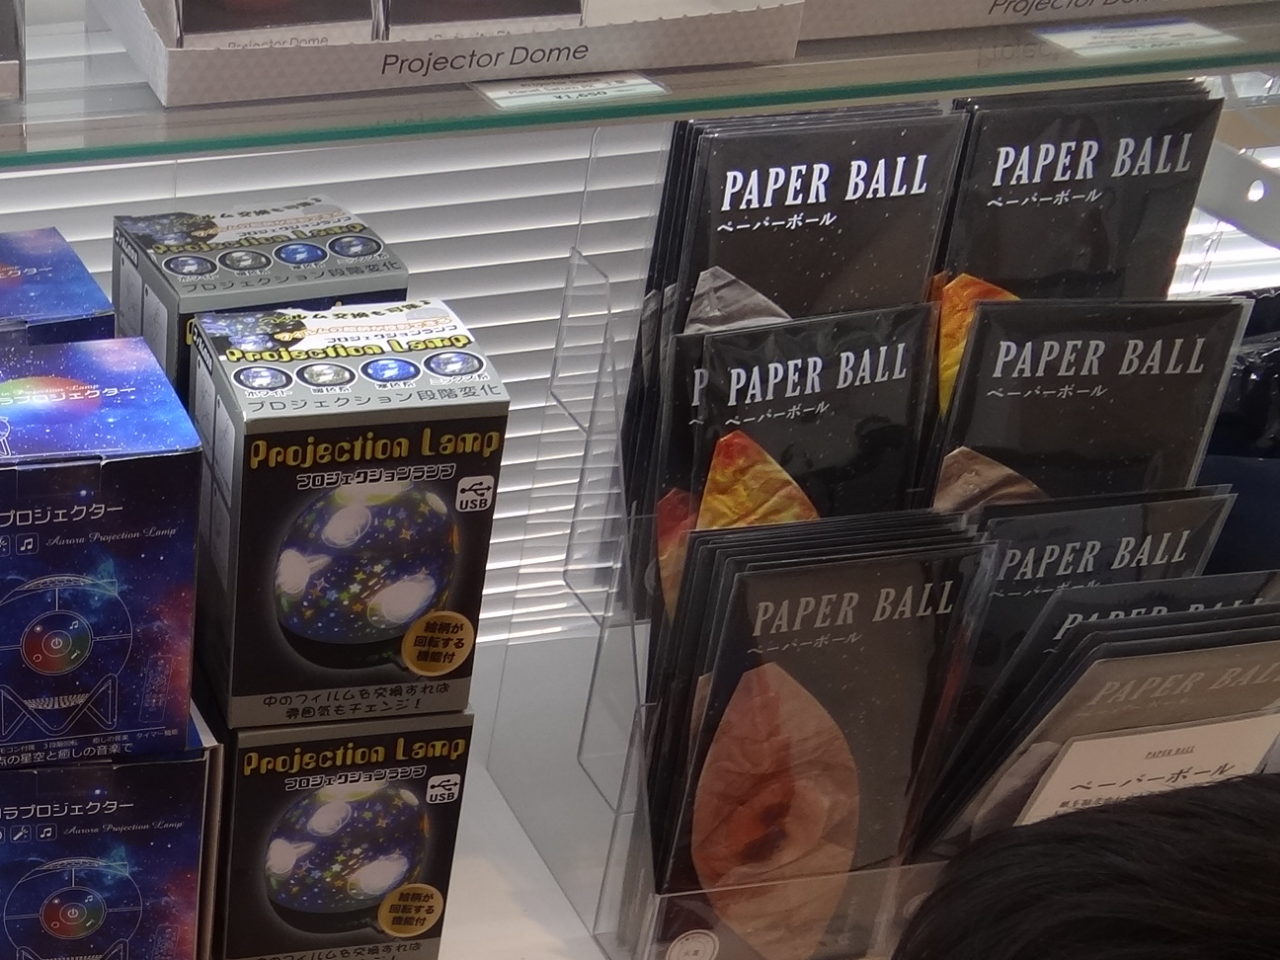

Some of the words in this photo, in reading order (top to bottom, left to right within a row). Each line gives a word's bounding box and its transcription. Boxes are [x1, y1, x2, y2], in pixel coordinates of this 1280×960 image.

[381, 48, 504, 76] Projector
[509, 42, 590, 68] Dome
[991, 139, 1098, 187] PAPER
[1111, 132, 1193, 178] BALL
[721, 163, 829, 211] PAPER
[845, 154, 928, 201] BALL
[987, 188, 1102, 208] ペーパーボール
[717, 212, 837, 232] ペーパーボール
[226, 343, 384, 364] Projection
[388, 334, 472, 354] Lamp
[991, 340, 1103, 379] PAPER
[1119, 337, 1207, 376] BALL
[727, 357, 823, 407] PAPER
[837, 343, 908, 391] BALL
[247, 383, 501, 413] プロジェクション段階変化
[987, 384, 1108, 400] ペーパーボール
[725, 402, 830, 427] ペーパーボール
[250, 431, 410, 470] Projection
[422, 428, 501, 457] Lamp
[296, 463, 457, 490] プロジェクションランプ
[459, 499, 488, 510] USB
[996, 540, 1102, 582] PAPER
[1111, 529, 1193, 569] BALL
[752, 591, 860, 637] PAPER
[872, 580, 955, 622] BALL
[414, 635, 465, 649] 回転する
[747, 631, 863, 655] ペーパーボール
[1089, 671, 1205, 705] PAPER
[243, 742, 385, 776] Projection
[396, 737, 466, 761] Lamp
[1144, 749, 1172, 759] PAPER
[1175, 745, 1196, 755] BALL
[284, 765, 427, 792] プロジェクションランプ
[1070, 762, 1236, 791] ペーパーボール
[429, 791, 455, 802] USB
